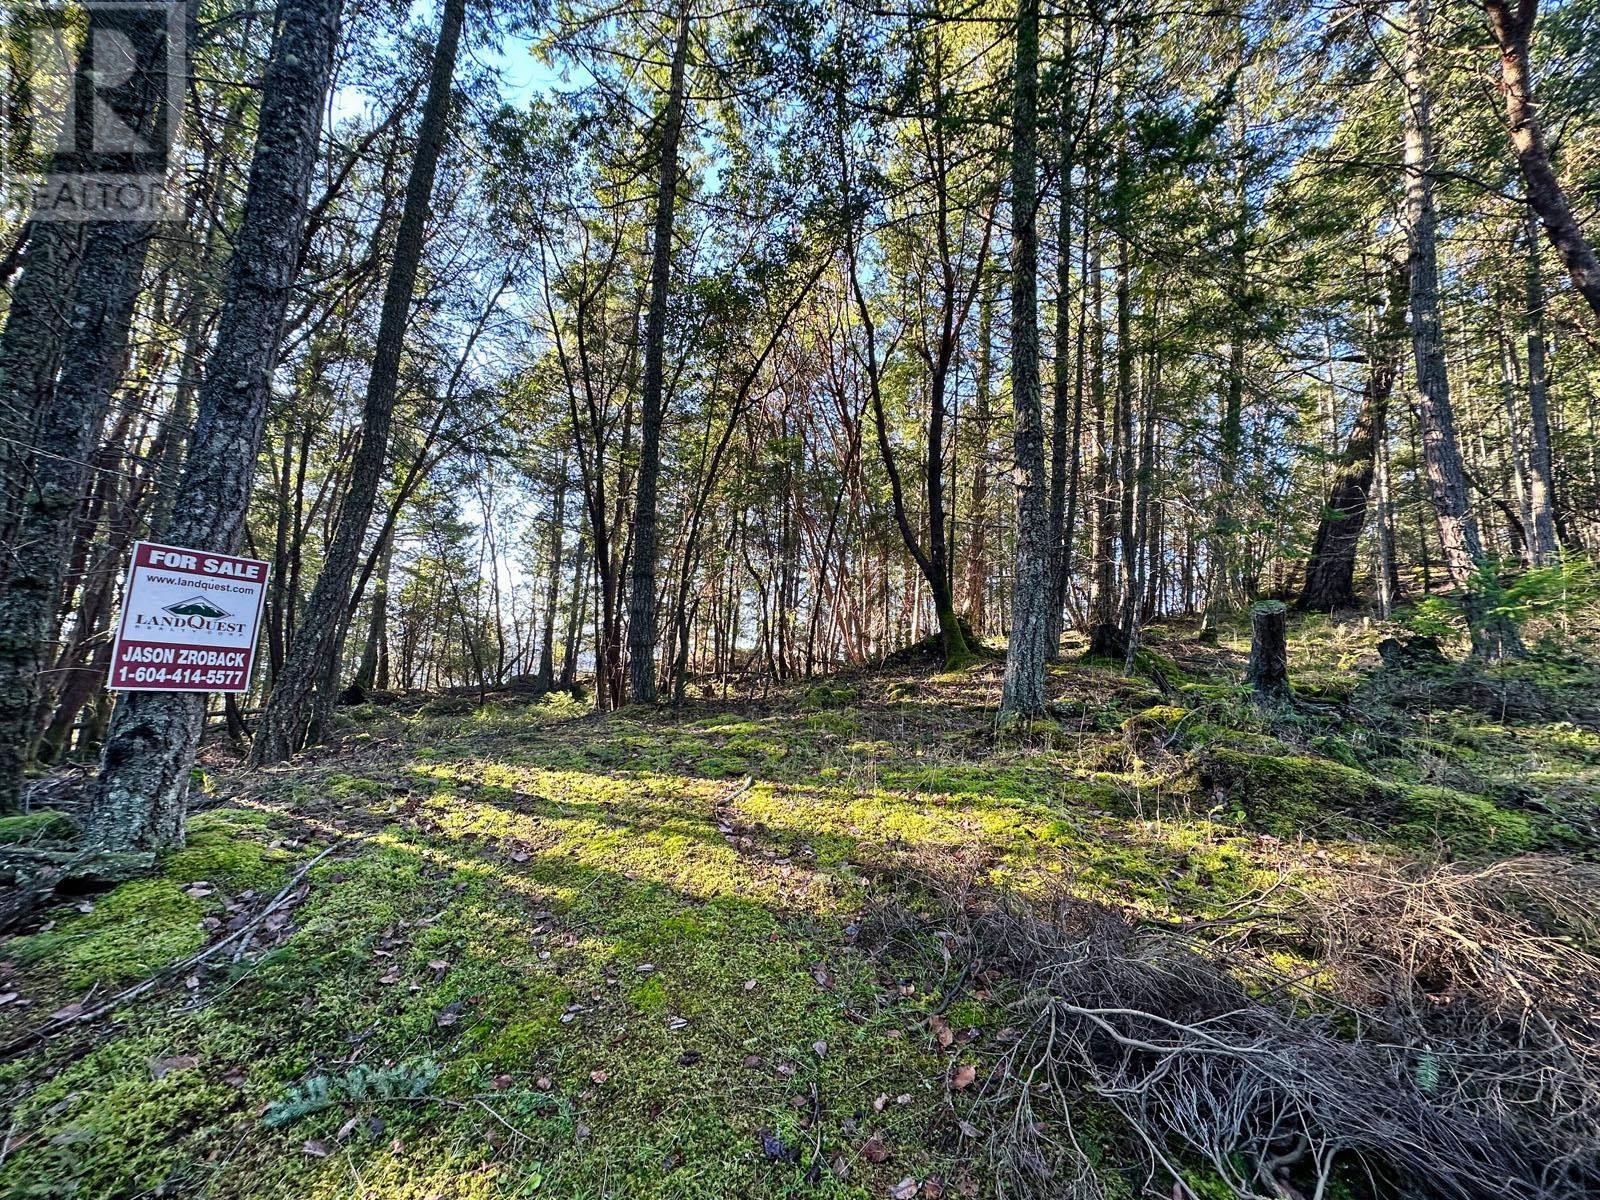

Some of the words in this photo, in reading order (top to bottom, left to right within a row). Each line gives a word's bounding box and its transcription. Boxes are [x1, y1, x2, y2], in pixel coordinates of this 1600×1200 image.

[149, 550, 197, 570] FOR
[203, 558, 260, 579] SALE
[147, 574, 254, 595] www.landquest.com
[122, 646, 174, 664] JASON
[177, 650, 245, 667] ZROBACK
[119, 666, 243, 684] 1-604-414-5577
